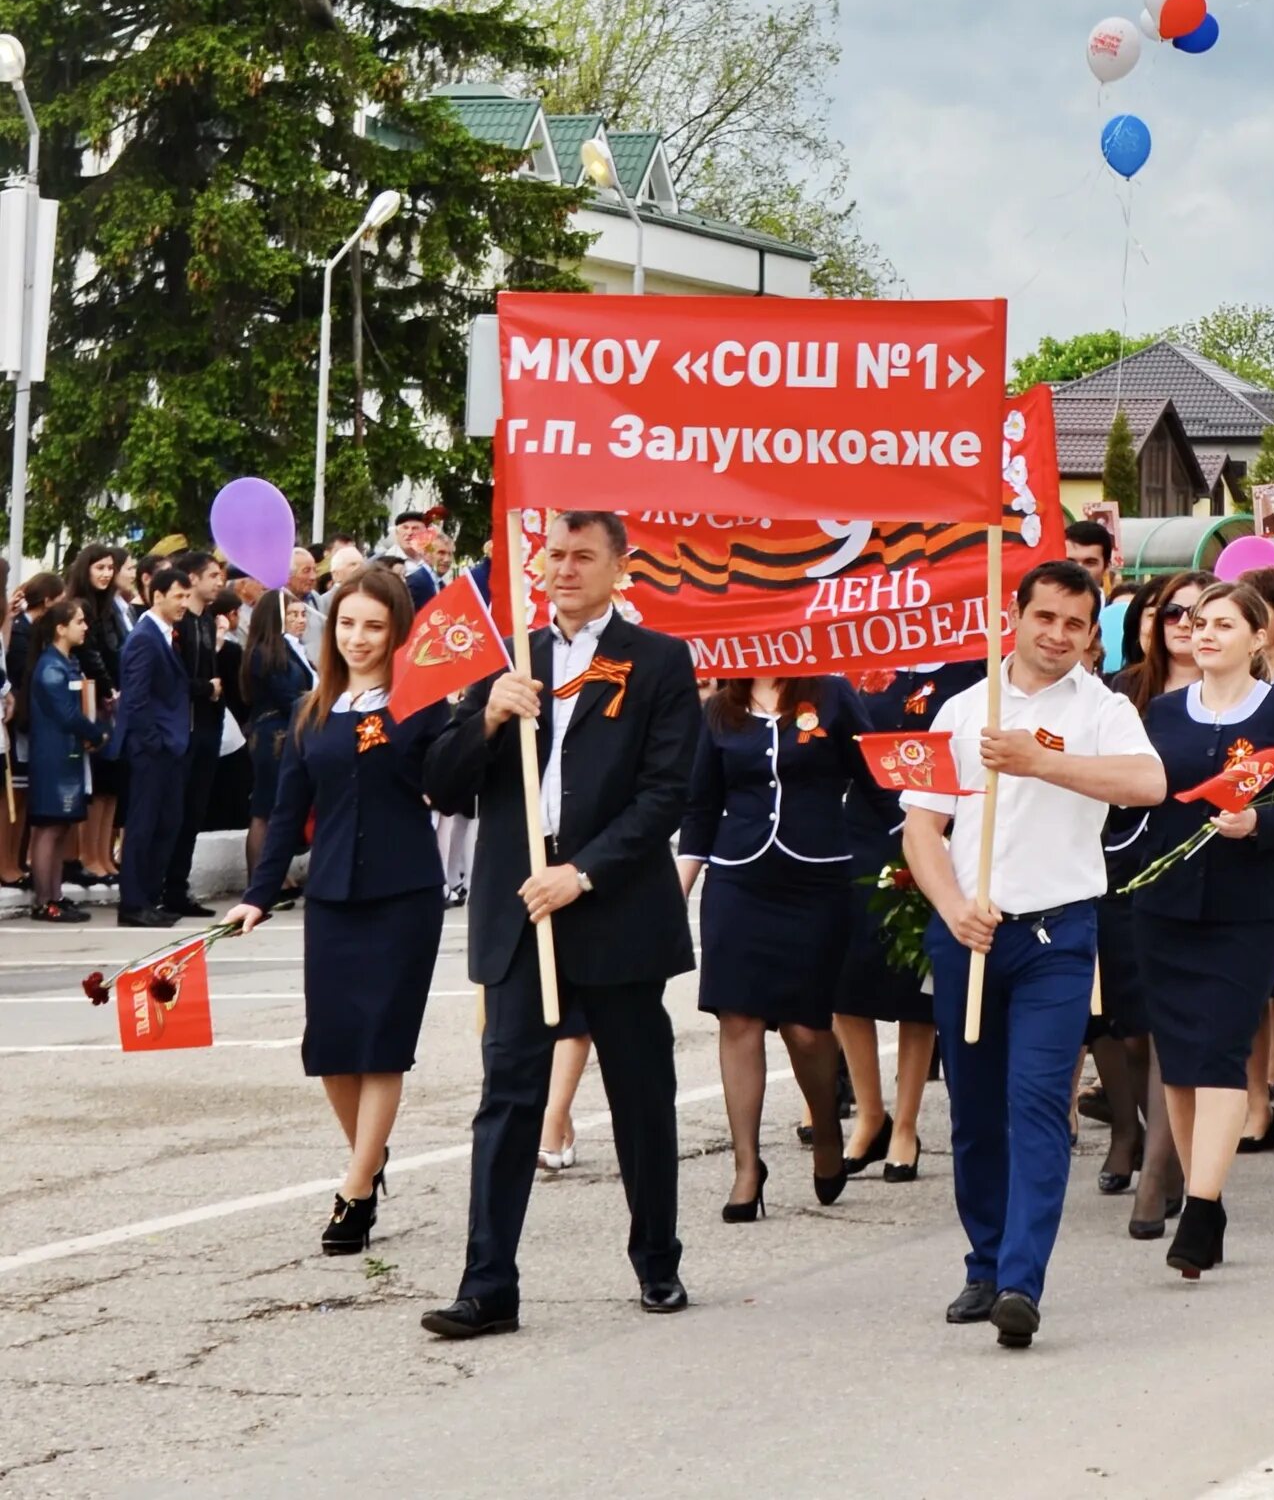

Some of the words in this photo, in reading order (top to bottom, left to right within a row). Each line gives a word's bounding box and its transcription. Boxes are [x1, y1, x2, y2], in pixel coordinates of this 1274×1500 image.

[508, 336, 661, 385] МКОУ
[673, 340, 839, 388] «СОШ
[856, 342, 985, 389] №1»
[507, 418, 592, 456] г.п.
[608, 414, 982, 473] Залукокоаже
[805, 567, 931, 620] ДЕНЬ
